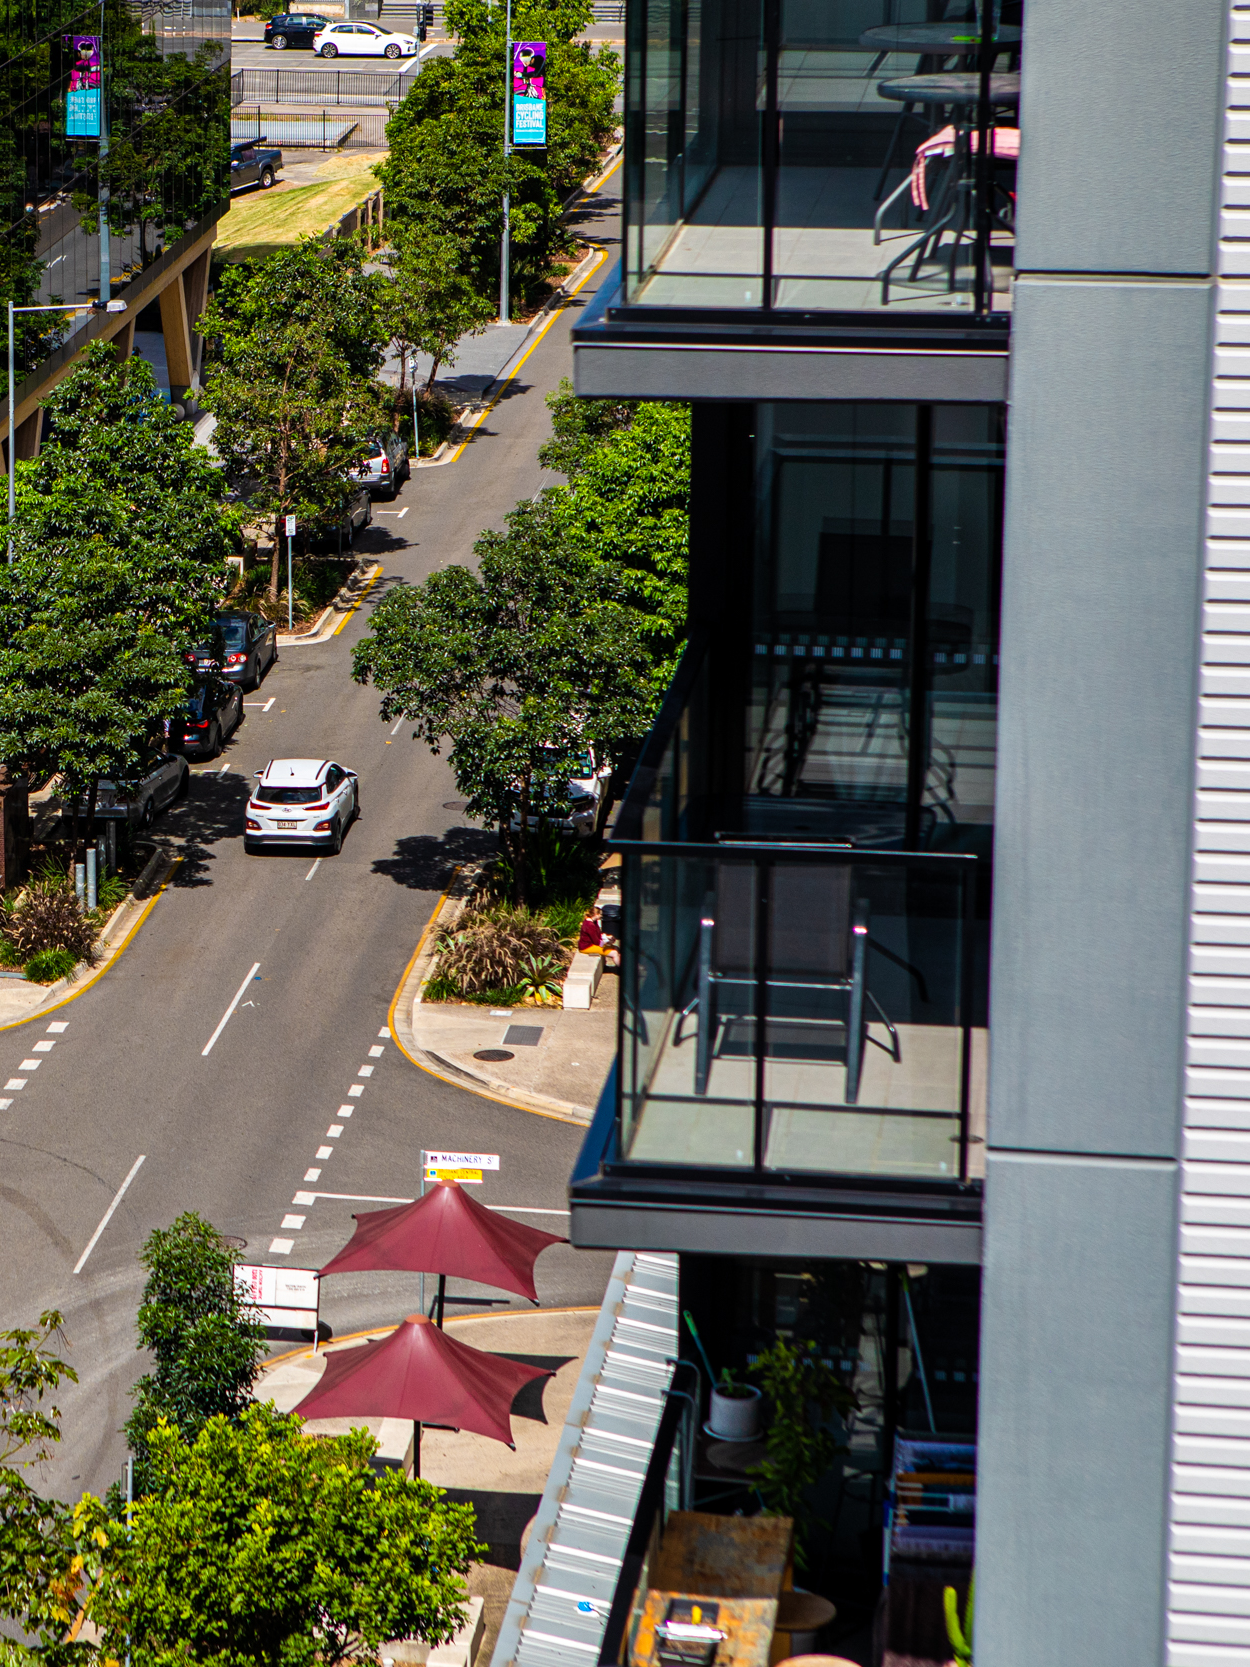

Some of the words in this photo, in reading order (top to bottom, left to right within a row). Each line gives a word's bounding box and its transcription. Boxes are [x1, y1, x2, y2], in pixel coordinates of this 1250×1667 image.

[516, 103, 544, 111] BRISBANE
[516, 111, 544, 120] CYCLING
[516, 120, 544, 128] FESTIVAL
[441, 1154, 482, 1164] MACHINERY
